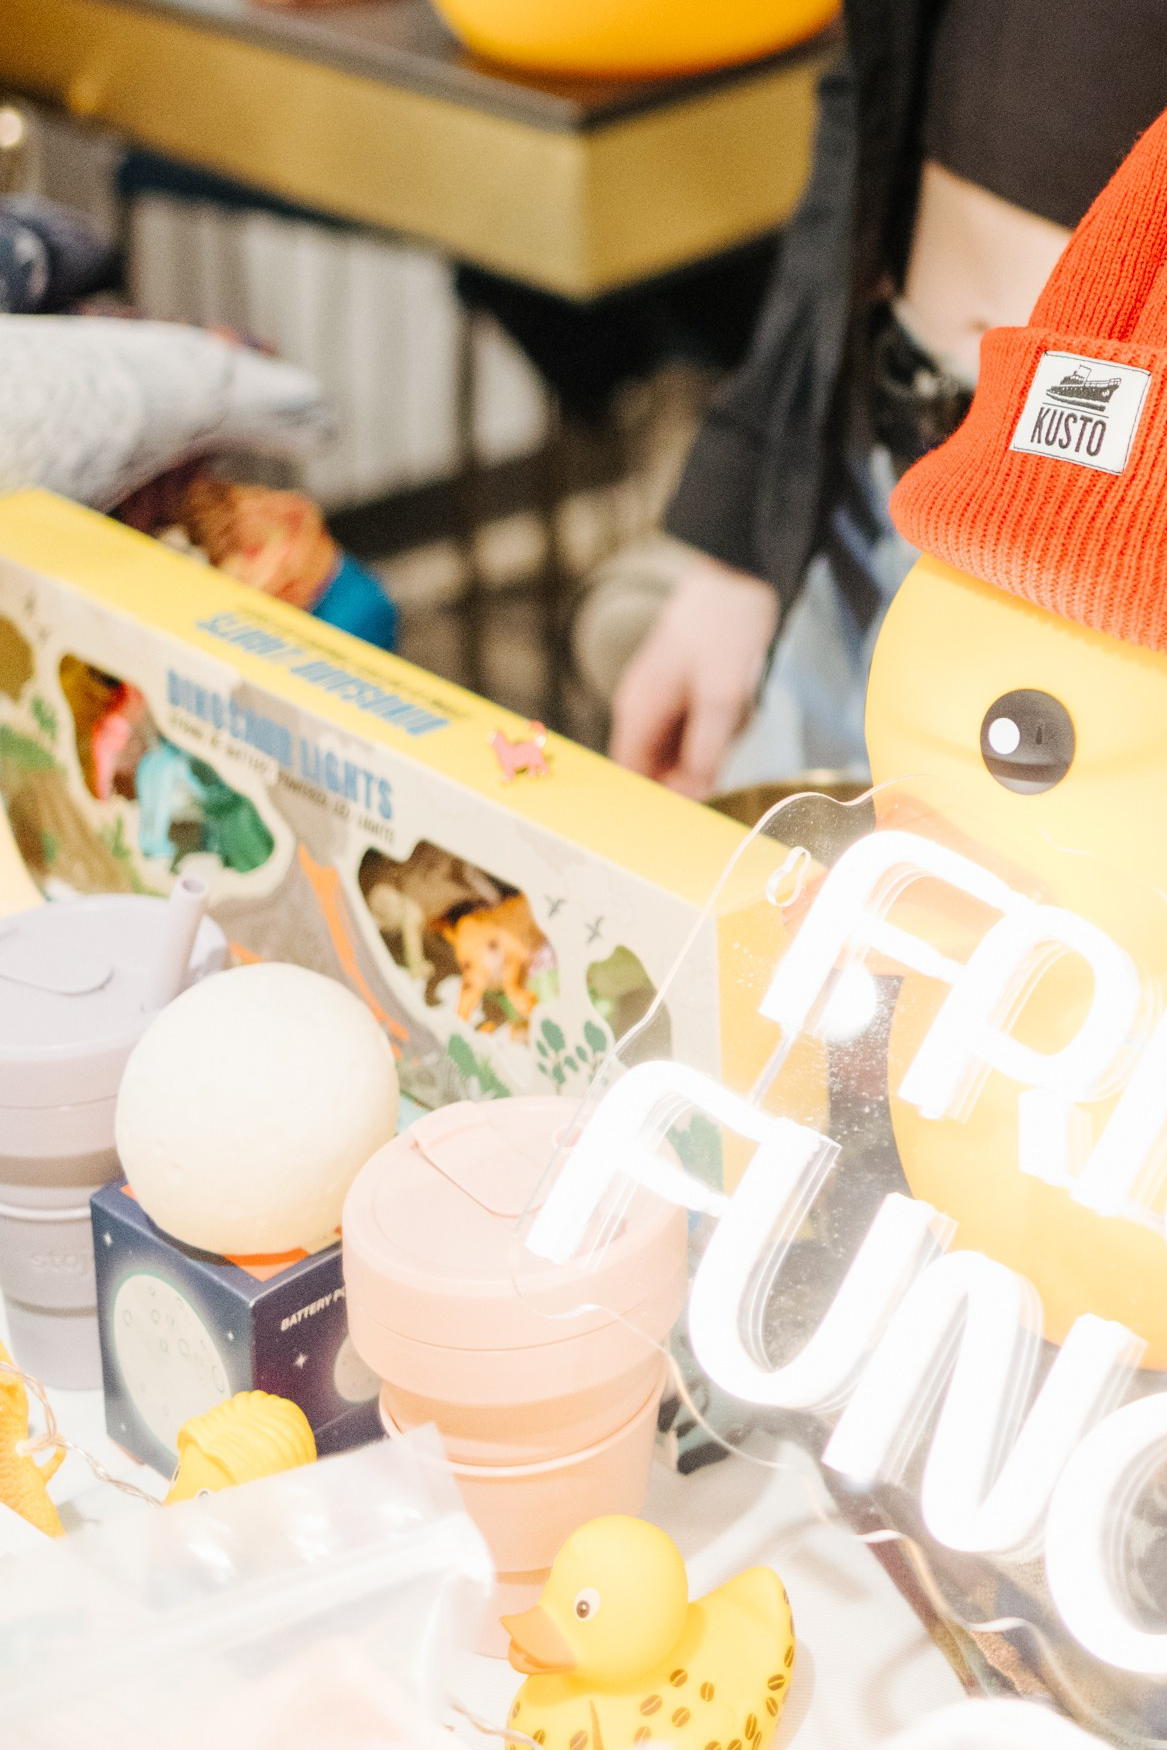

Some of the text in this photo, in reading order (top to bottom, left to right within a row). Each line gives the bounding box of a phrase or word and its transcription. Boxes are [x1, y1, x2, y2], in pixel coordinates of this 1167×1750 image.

[1010, 406, 1107, 457] KUSTO
[300, 735, 392, 821] LIGHTS
[281, 1292, 332, 1332] BATTERY
